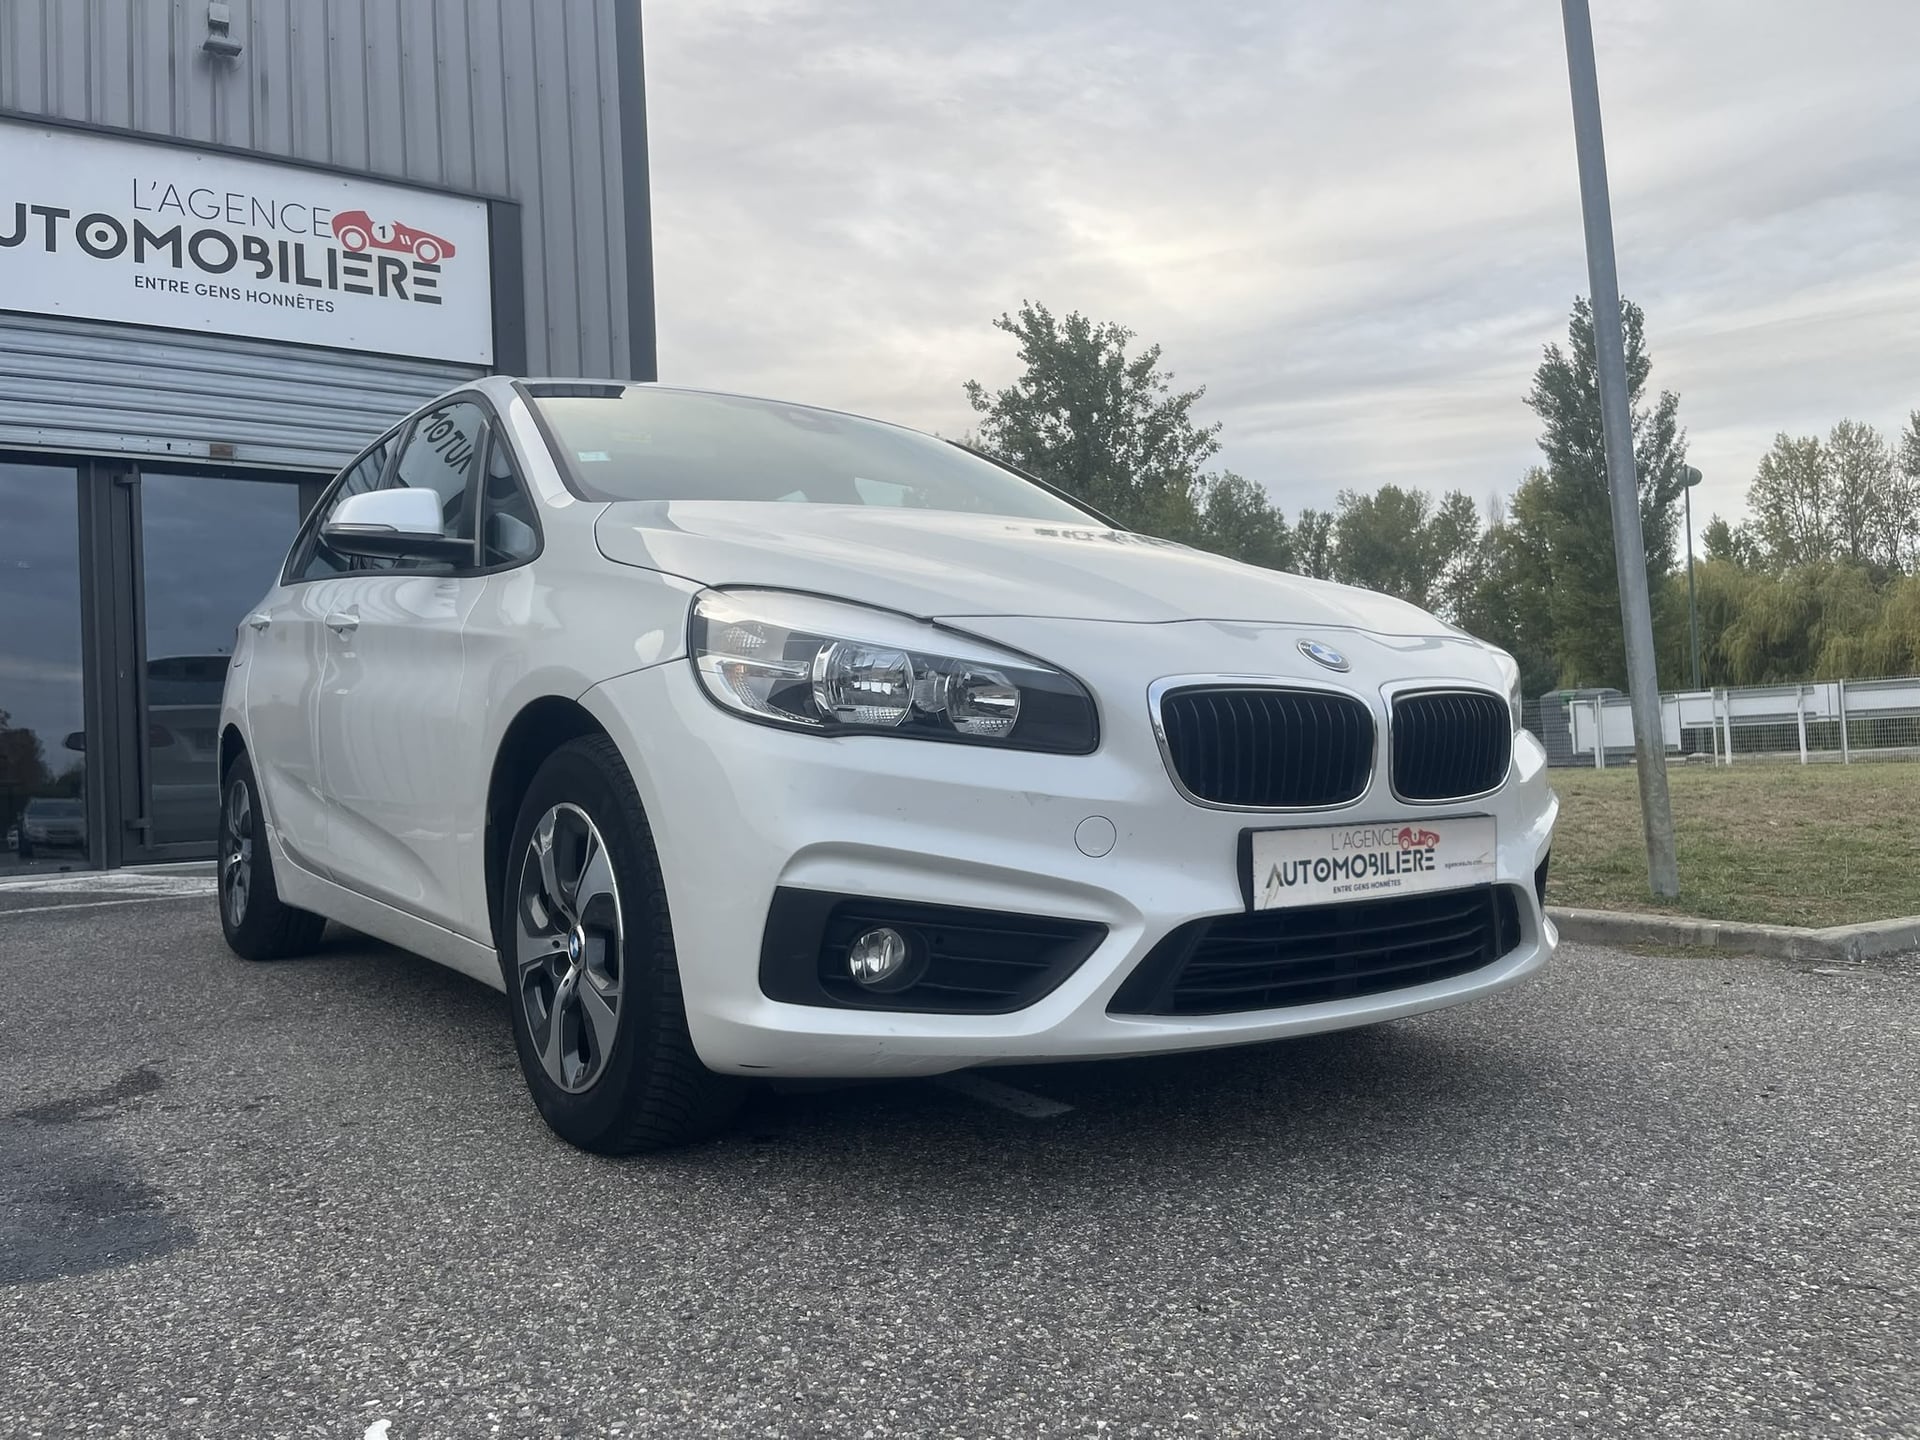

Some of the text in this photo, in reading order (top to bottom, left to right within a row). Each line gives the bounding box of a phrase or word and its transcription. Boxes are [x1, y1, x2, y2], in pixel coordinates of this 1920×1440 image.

[133, 177, 332, 239] L'AGENCE
[378, 225, 386, 239] 1
[134, 275, 335, 313] ENTRE GENS HONNÊTES
[1331, 827, 1399, 851] L'AGENCE
[1333, 884, 1352, 894] ENTRE
[1353, 882, 1370, 892] GENS
